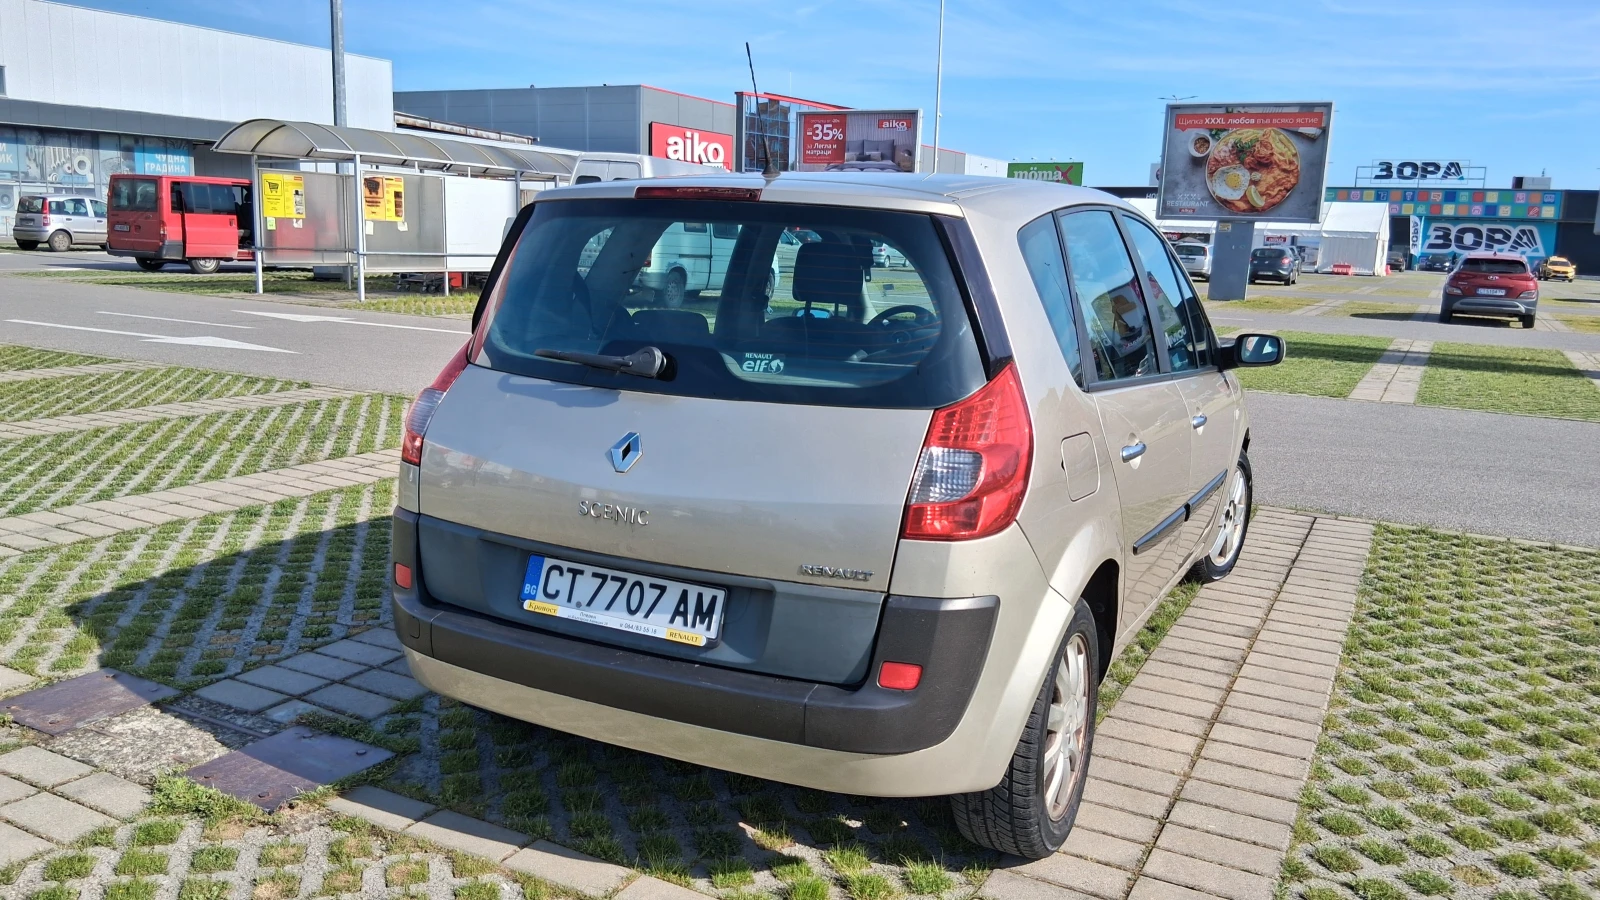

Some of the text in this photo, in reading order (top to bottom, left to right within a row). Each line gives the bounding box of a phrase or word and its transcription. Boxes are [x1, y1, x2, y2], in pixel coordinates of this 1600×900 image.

[882, 119, 907, 128] aiko
[1227, 116, 1255, 124] любов
[807, 123, 843, 140] -35%
[666, 130, 725, 163] aiko
[155, 153, 186, 164] ЧУДНА
[144, 162, 187, 173] ГРАДИНА
[1373, 161, 1465, 180] ЗОРА
[1425, 225, 1541, 253] ЗОРА
[745, 352, 774, 360] RENAULT
[742, 359, 769, 372] elf
[578, 500, 650, 526] SCENIC
[799, 564, 875, 581] RENAULT
[524, 583, 537, 595] BG
[542, 564, 718, 632] CT 7707 AM
[669, 631, 699, 643] RENAULT
